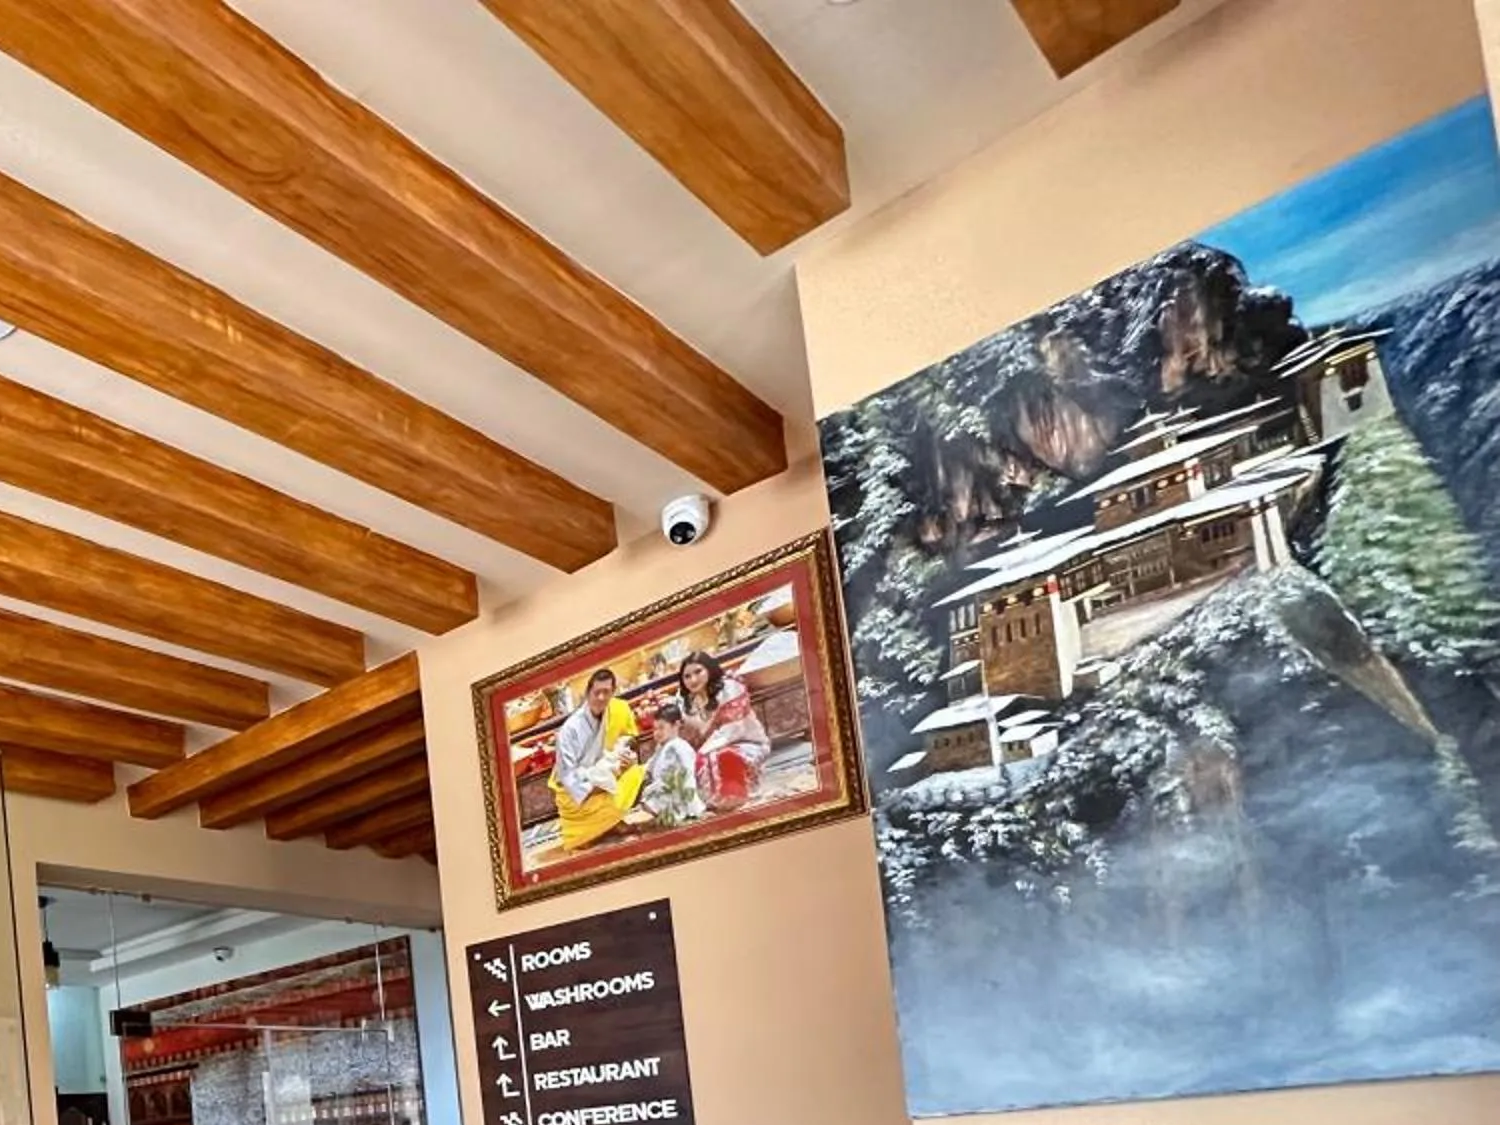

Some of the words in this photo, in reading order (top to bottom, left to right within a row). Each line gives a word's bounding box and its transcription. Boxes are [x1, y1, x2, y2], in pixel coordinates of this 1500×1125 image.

[521, 942, 592, 972] ROOMS
[525, 972, 655, 1011] WASHROOMS
[530, 1029, 571, 1051] BAR
[534, 1057, 661, 1092] RESTAURANT
